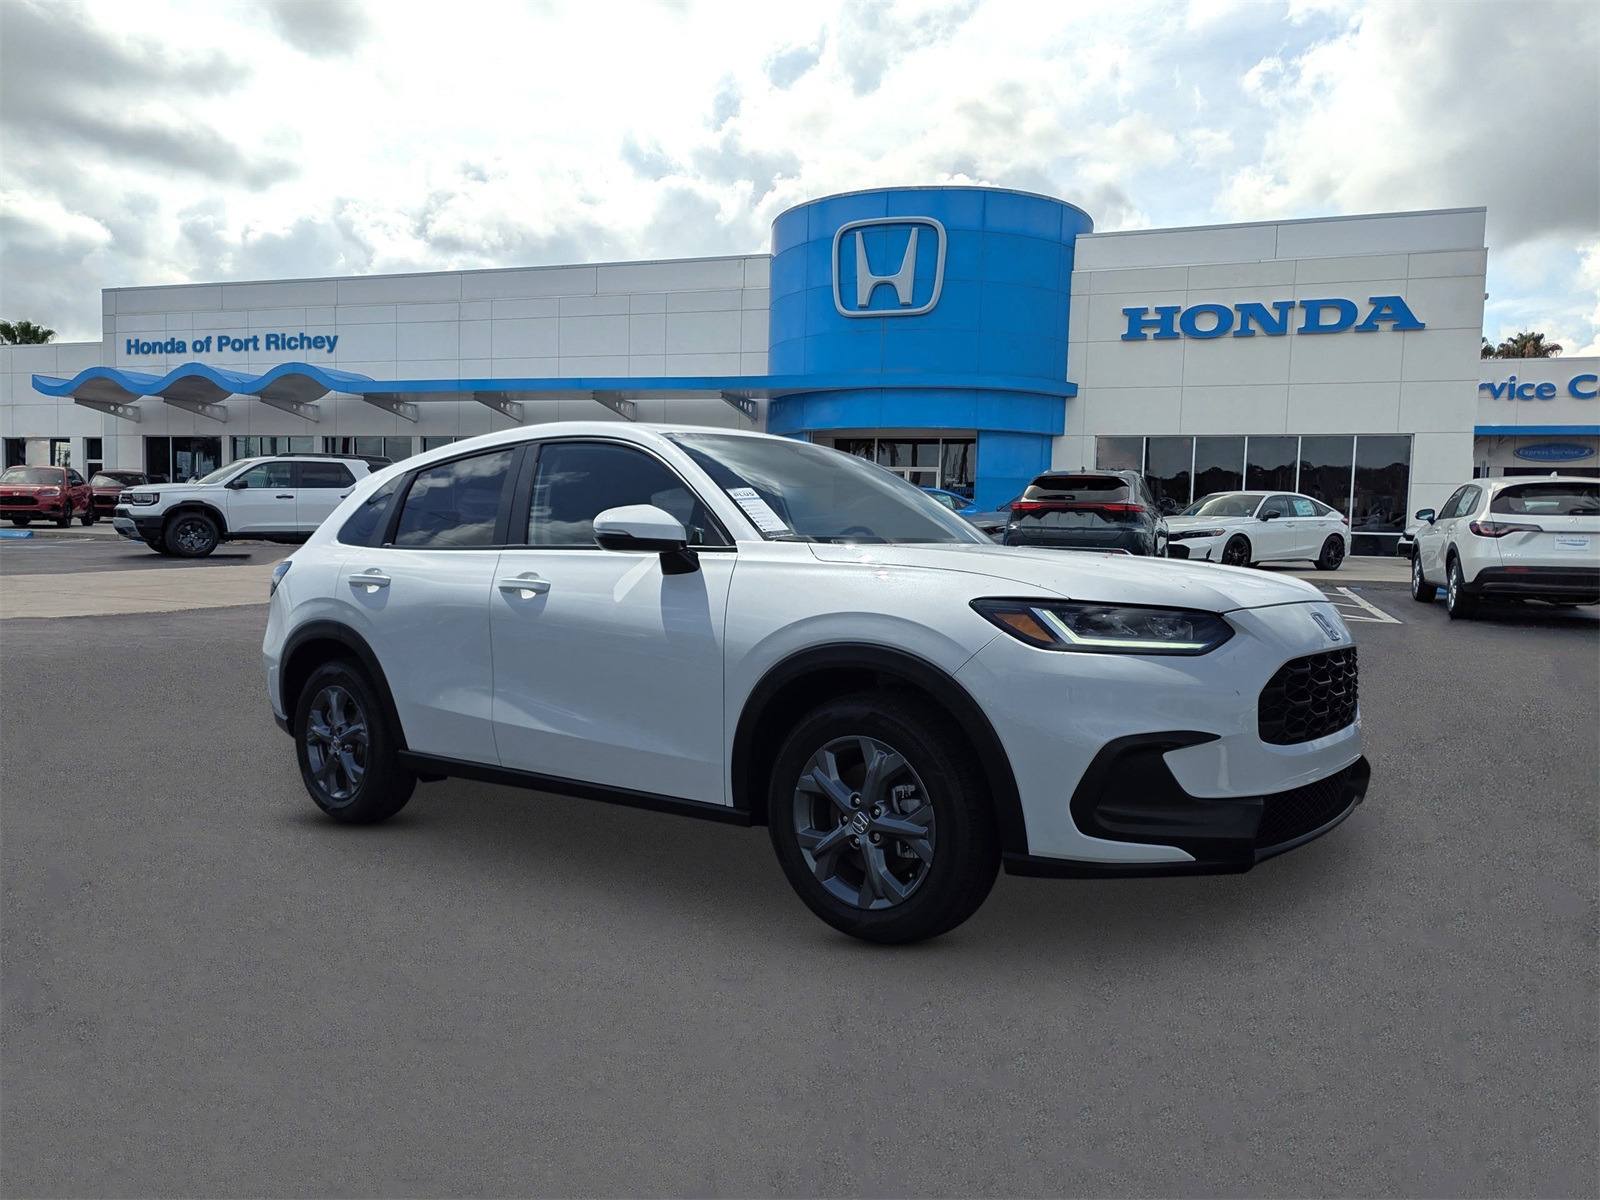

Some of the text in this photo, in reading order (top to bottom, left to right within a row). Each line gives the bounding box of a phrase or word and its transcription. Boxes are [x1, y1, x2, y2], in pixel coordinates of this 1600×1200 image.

[1121, 295, 1426, 341] HONDA
[126, 332, 339, 355] Honda of Port Richey
[1567, 373, 1600, 400] C
[1519, 448, 1580, 457] Express Service
